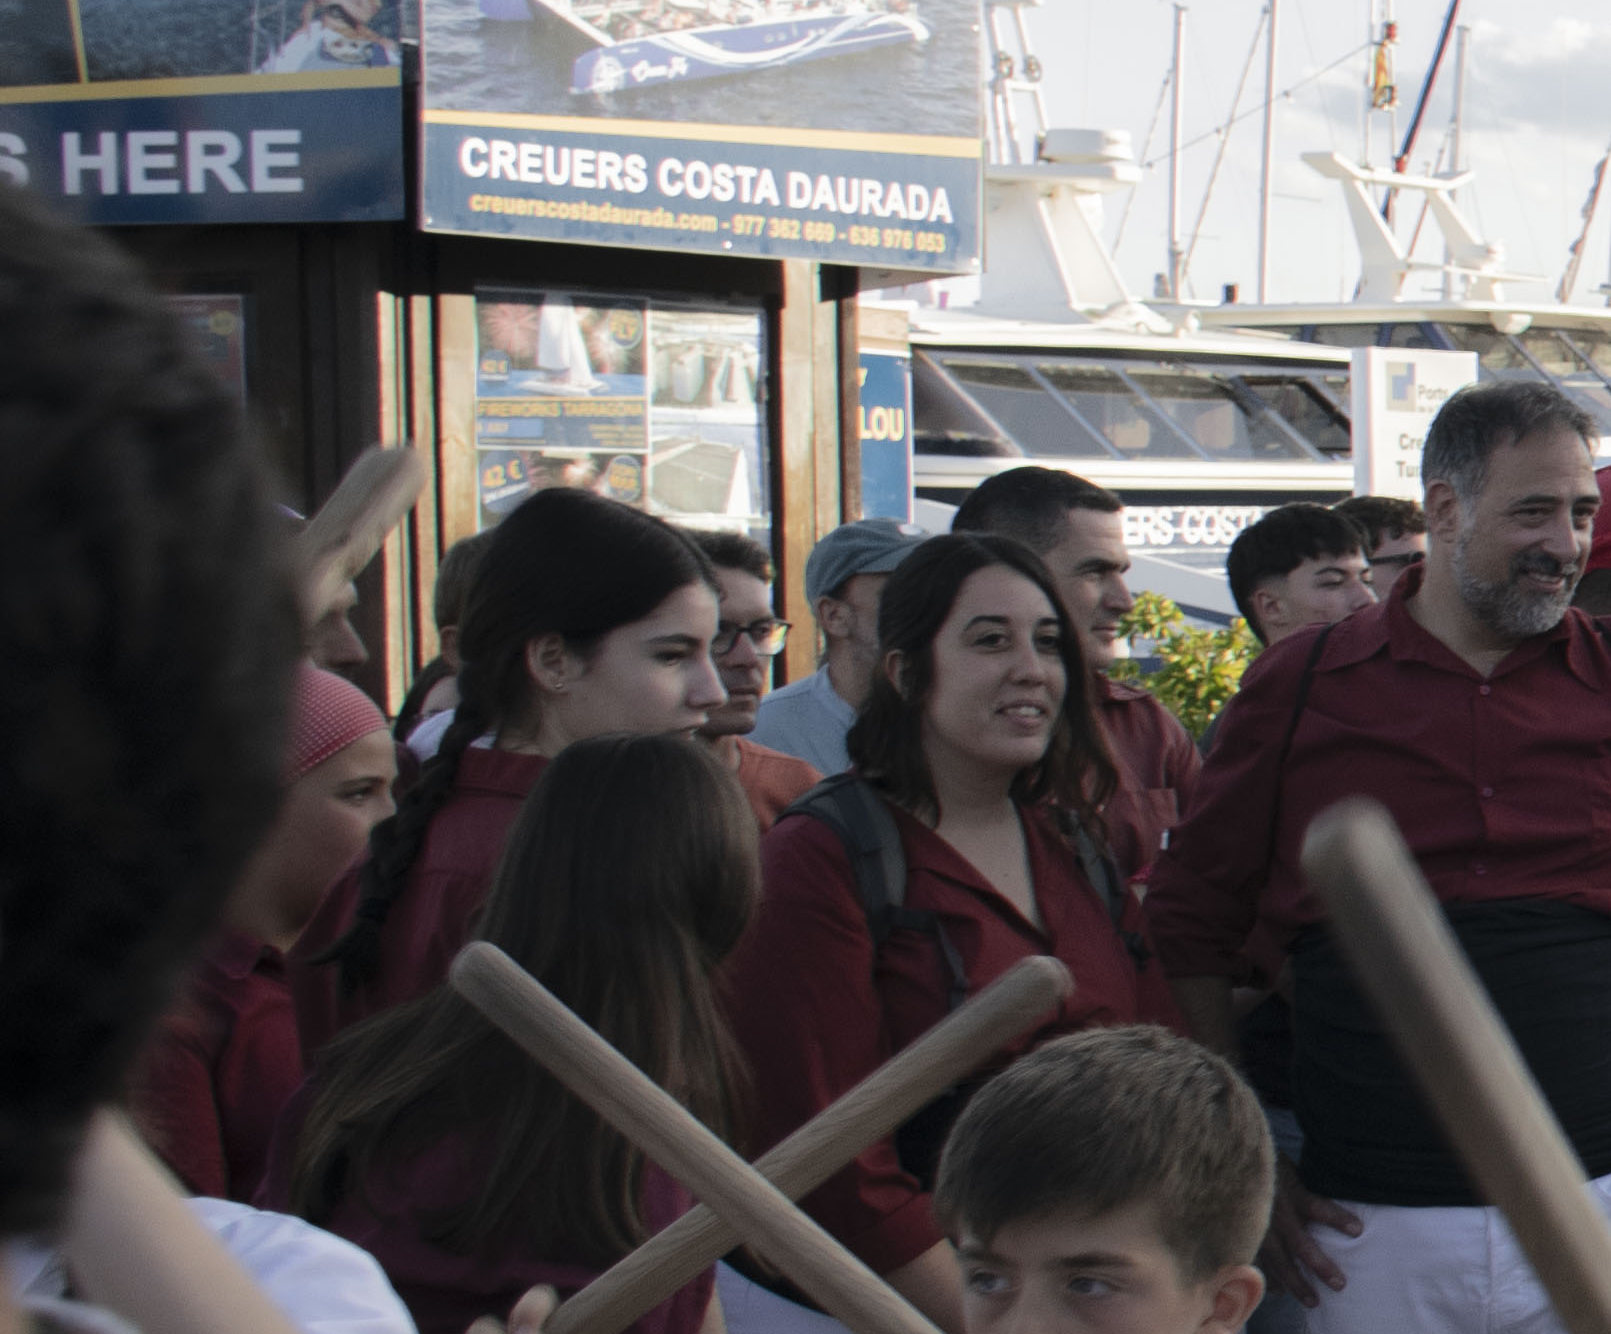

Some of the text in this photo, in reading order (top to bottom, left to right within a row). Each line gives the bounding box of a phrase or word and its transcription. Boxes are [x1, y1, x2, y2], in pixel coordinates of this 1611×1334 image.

[61, 129, 304, 195] HERE
[459, 136, 954, 224] CREUERS COSTA DAURADA
[469, 193, 718, 233] creuerscostadaurada.com
[731, 214, 766, 236] 977
[767, 217, 801, 240] 362
[882, 228, 914, 250] 976
[915, 231, 946, 254] 053
[478, 402, 644, 416] FIREWORKS TARRAGONA
[481, 464, 507, 488] 42
